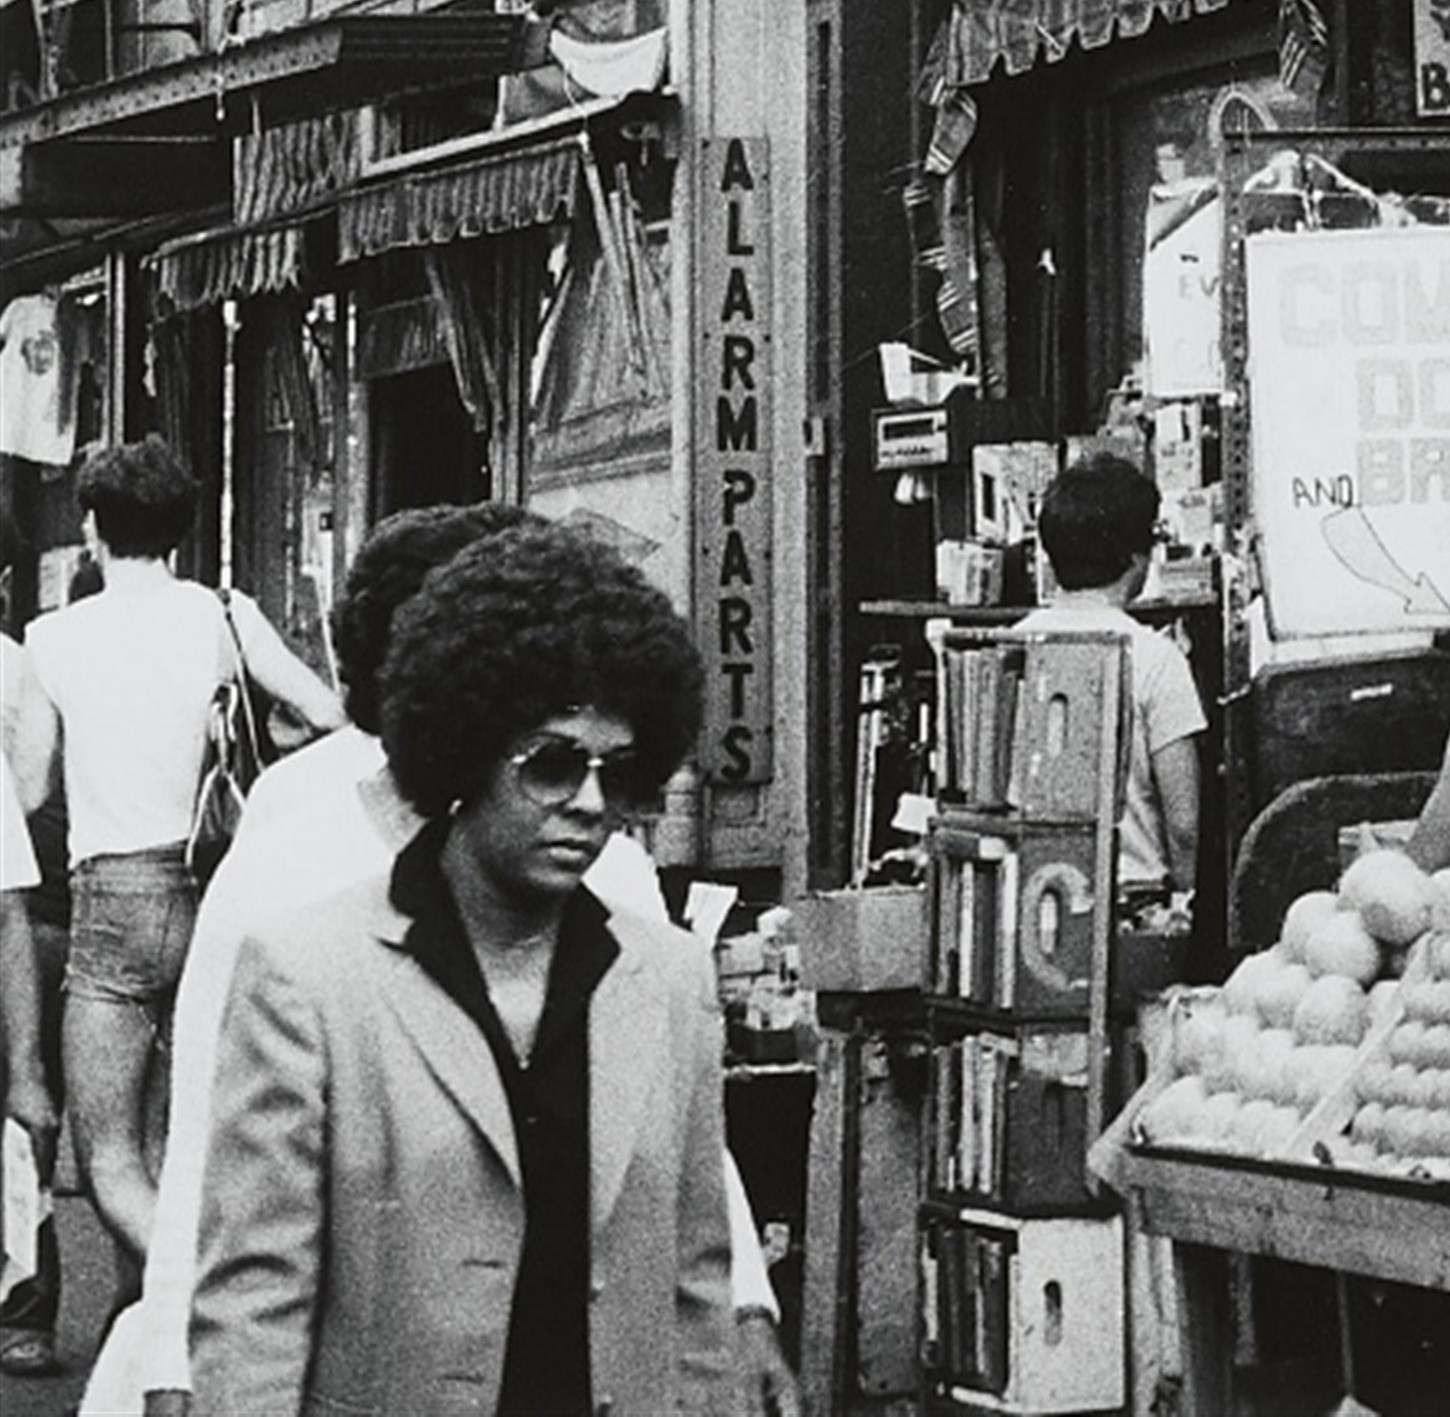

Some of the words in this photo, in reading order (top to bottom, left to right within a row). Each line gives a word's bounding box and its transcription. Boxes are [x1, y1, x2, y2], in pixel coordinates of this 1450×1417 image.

[716, 138, 757, 452] ALARM
[717, 470, 754, 781] PARTS
[1293, 475, 1353, 510] AND
